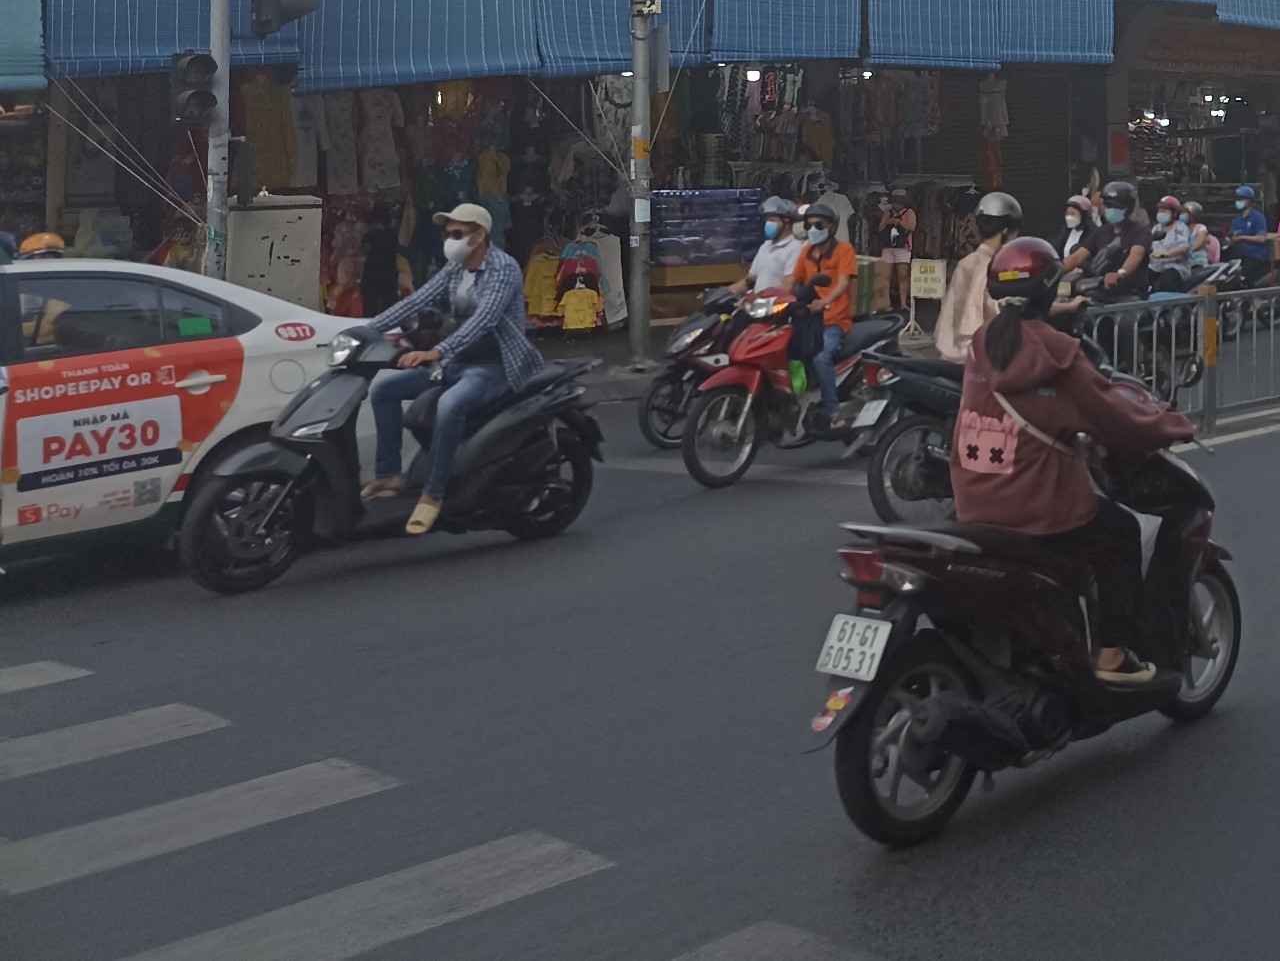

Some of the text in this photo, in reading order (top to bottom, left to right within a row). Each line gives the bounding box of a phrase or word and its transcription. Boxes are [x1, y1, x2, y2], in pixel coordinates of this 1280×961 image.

[277, 325, 311, 338] 9817
[14, 372, 152, 403] SHOPEEPAY QR
[42, 420, 160, 464] PAY30
[47, 503, 84, 520] Pay
